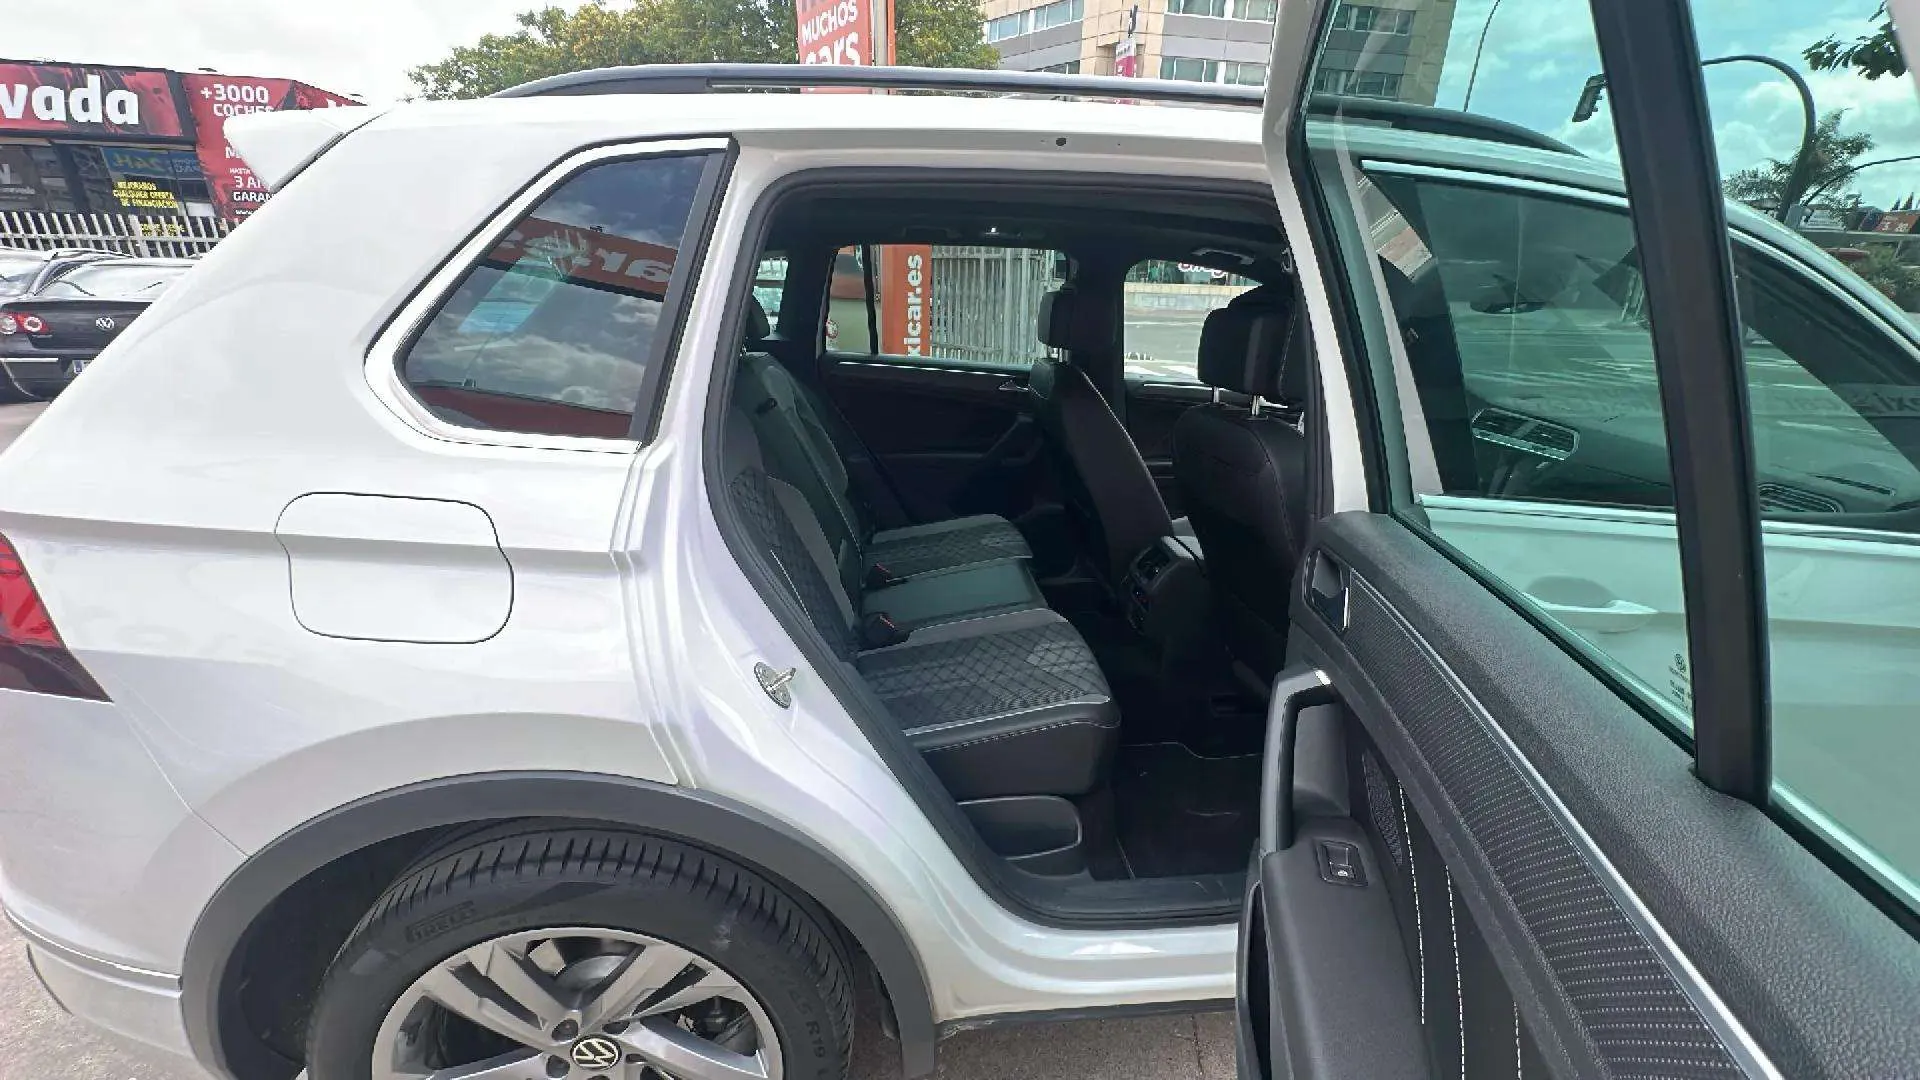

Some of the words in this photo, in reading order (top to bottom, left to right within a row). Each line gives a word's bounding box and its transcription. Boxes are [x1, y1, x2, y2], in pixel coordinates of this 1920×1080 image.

[802, 0, 858, 46] MUCHOS
[0, 74, 139, 124] vada
[200, 83, 269, 104] +3000
[234, 175, 244, 189] 3
